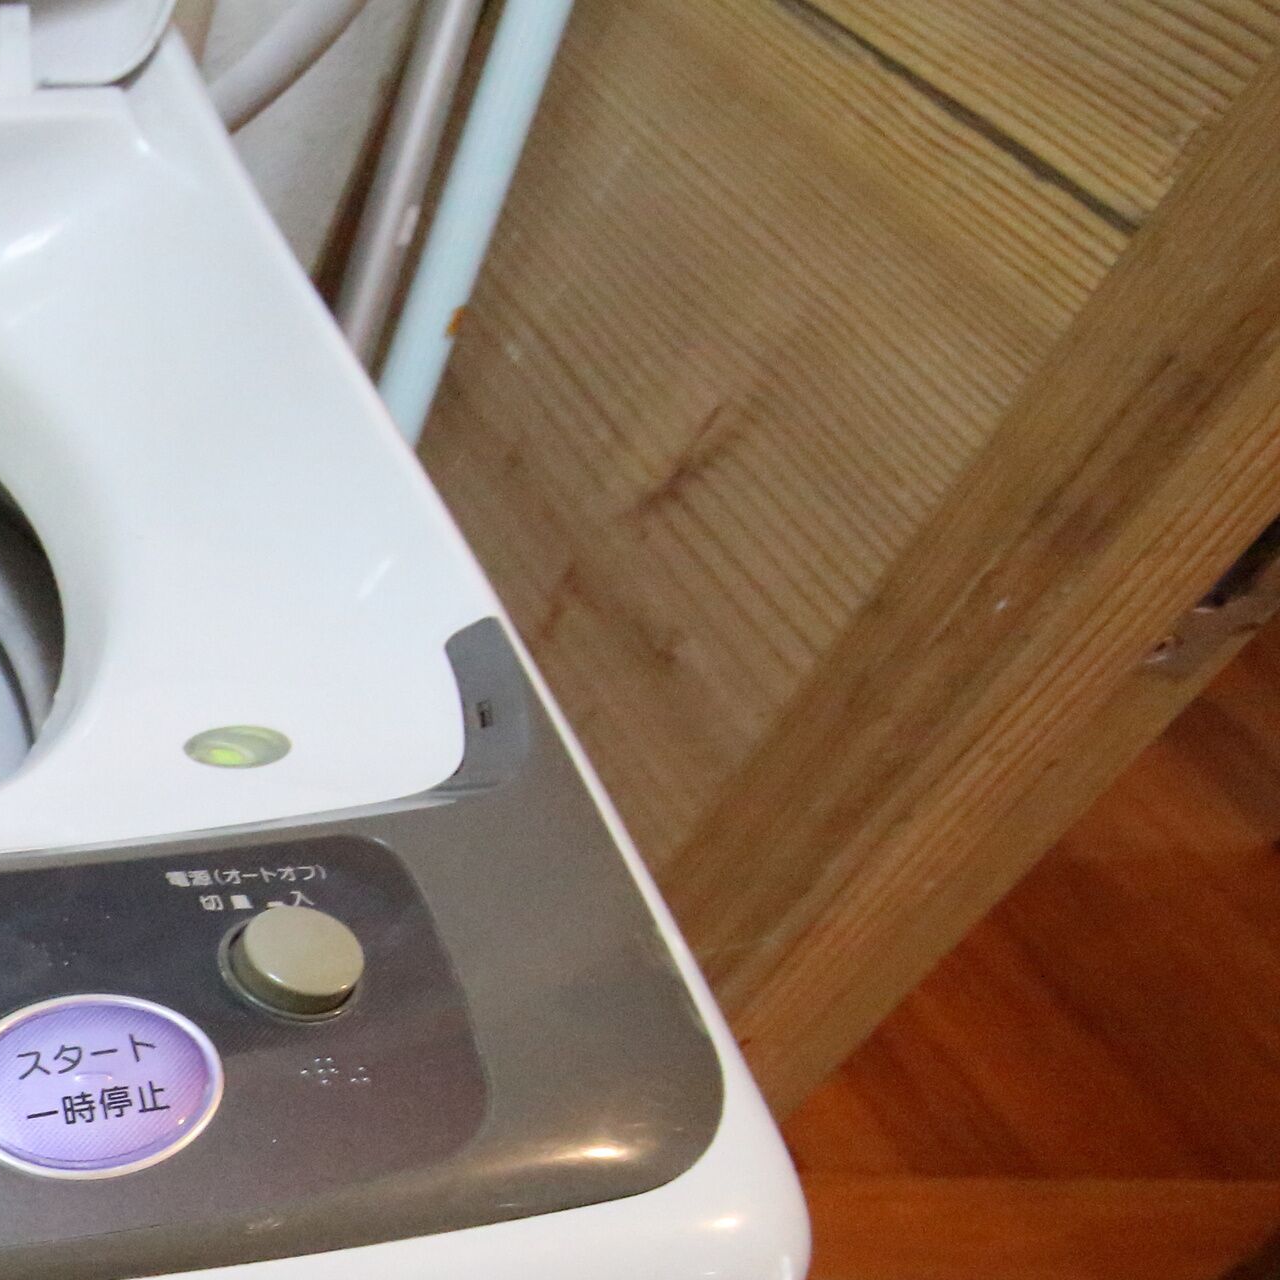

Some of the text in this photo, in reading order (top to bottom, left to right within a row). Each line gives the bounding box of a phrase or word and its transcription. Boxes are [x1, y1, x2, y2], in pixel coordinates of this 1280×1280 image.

[199, 895, 224, 911] 切
[16, 1033, 157, 1080] スタート
[26, 1080, 172, 1125] 一時停止
